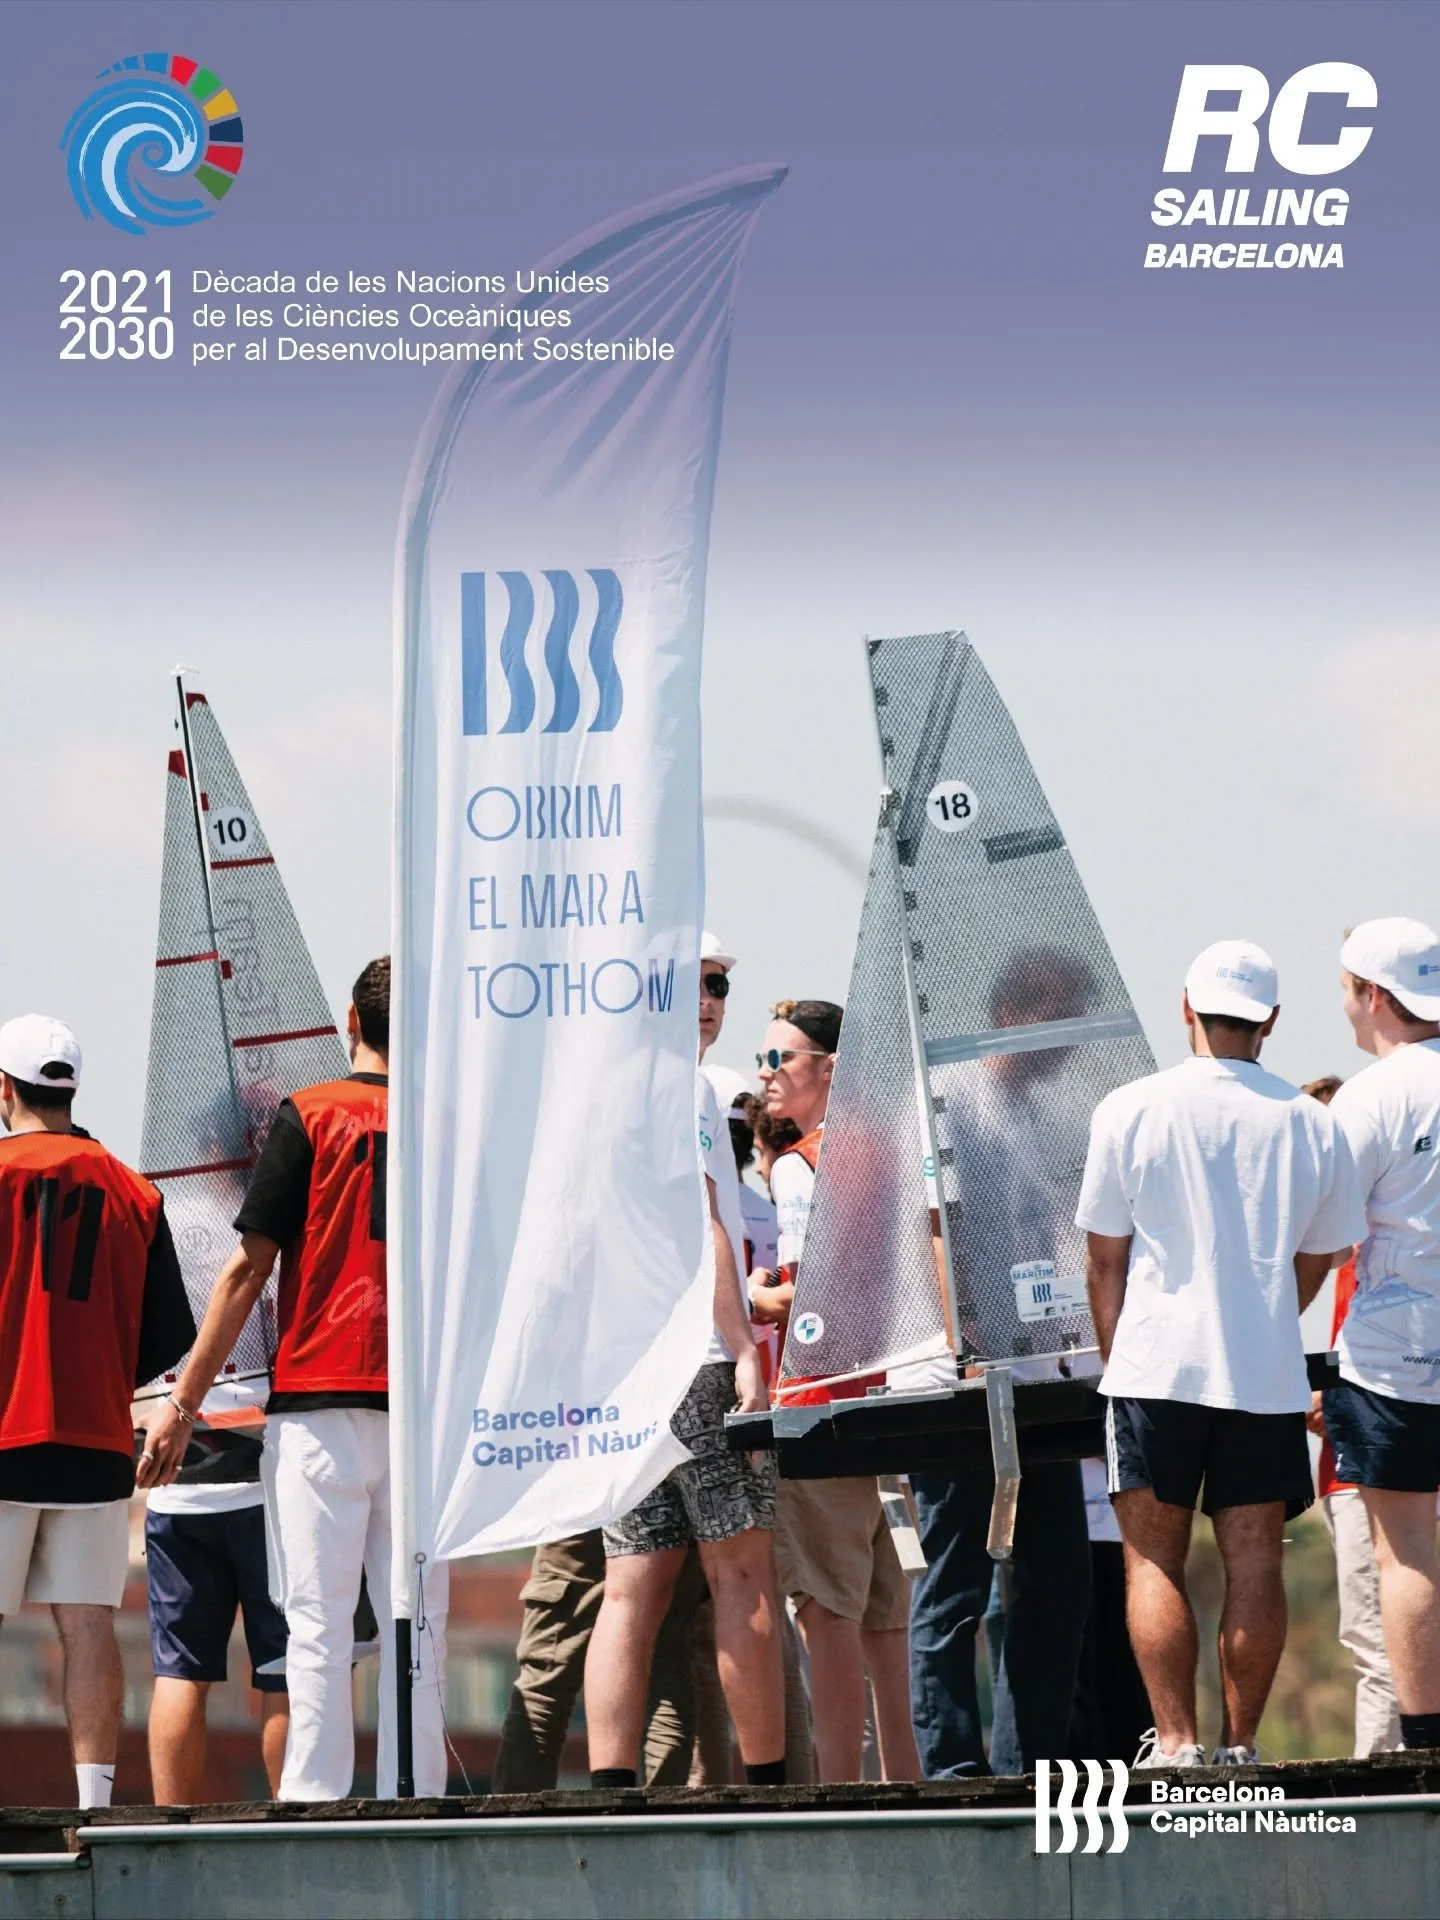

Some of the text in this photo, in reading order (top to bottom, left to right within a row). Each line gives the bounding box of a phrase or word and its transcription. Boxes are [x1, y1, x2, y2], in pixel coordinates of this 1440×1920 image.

[466, 784, 622, 842] OBRIM
[935, 792, 971, 820] 18
[213, 817, 247, 844] 10
[469, 870, 645, 931] EL MAR A
[467, 958, 675, 1020] TOTHOM
[472, 1402, 620, 1433] Barcelona
[472, 1435, 580, 1470] Capital
